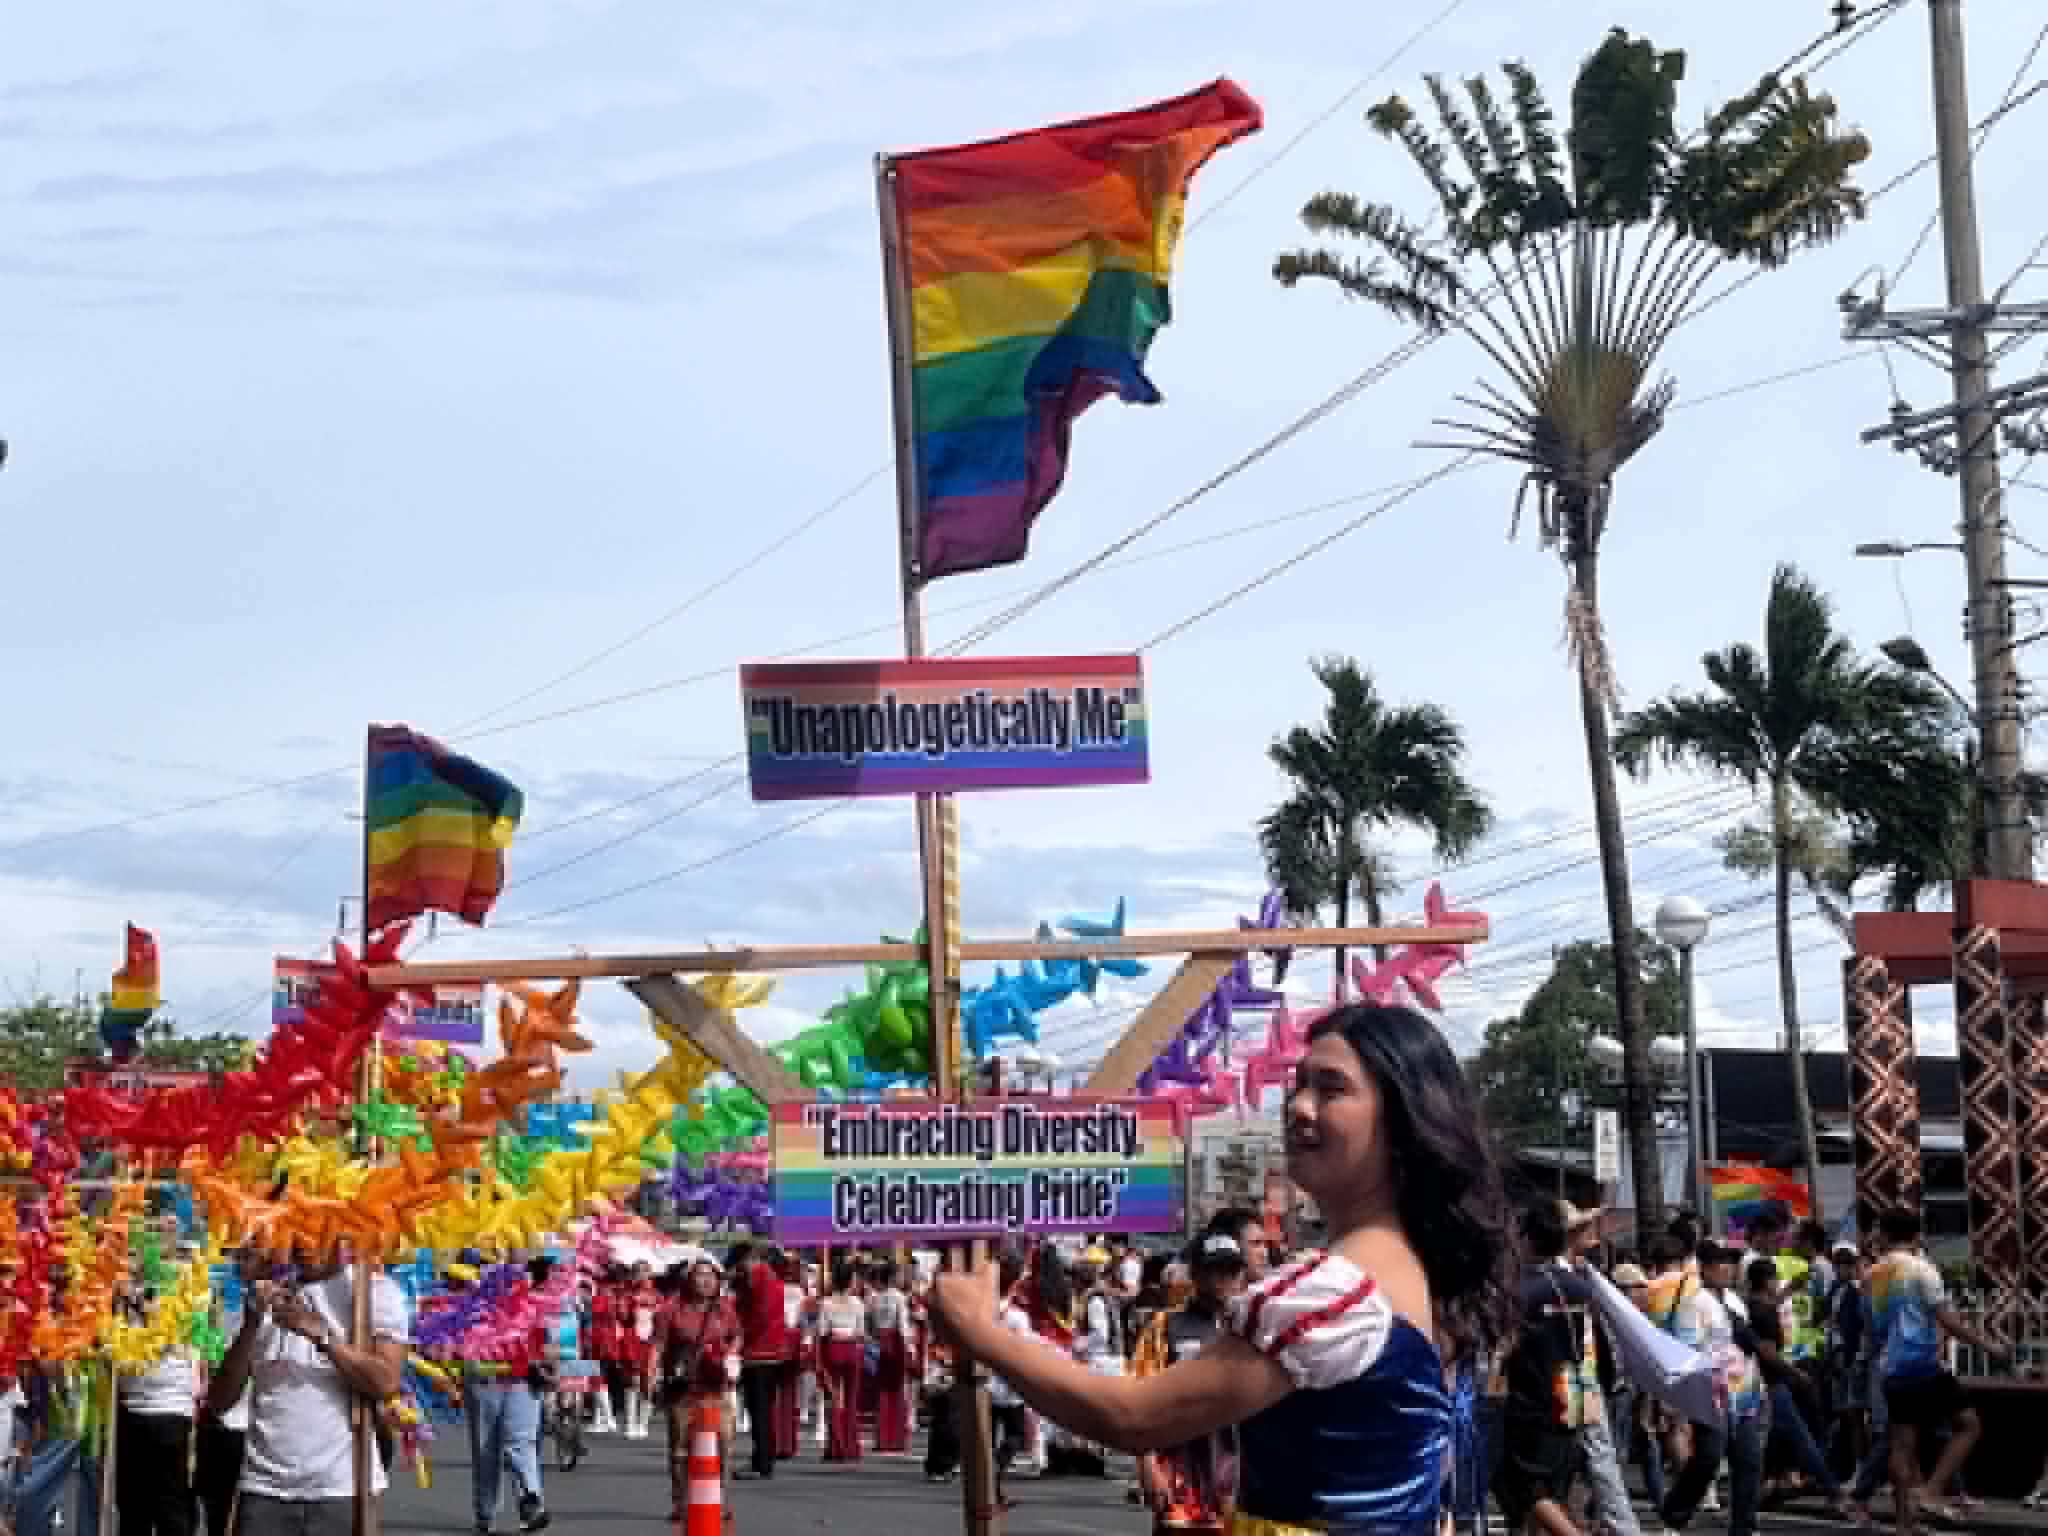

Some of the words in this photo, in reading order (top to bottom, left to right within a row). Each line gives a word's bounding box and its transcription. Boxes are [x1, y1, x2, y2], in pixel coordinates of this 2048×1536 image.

[752, 688, 1070, 763] "Unapologetically
[1073, 687, 1141, 749] Me"
[804, 1104, 993, 1159] "Embracing
[834, 1170, 1025, 1228] Celebrating
[1029, 1168, 1126, 1219] Pride"
